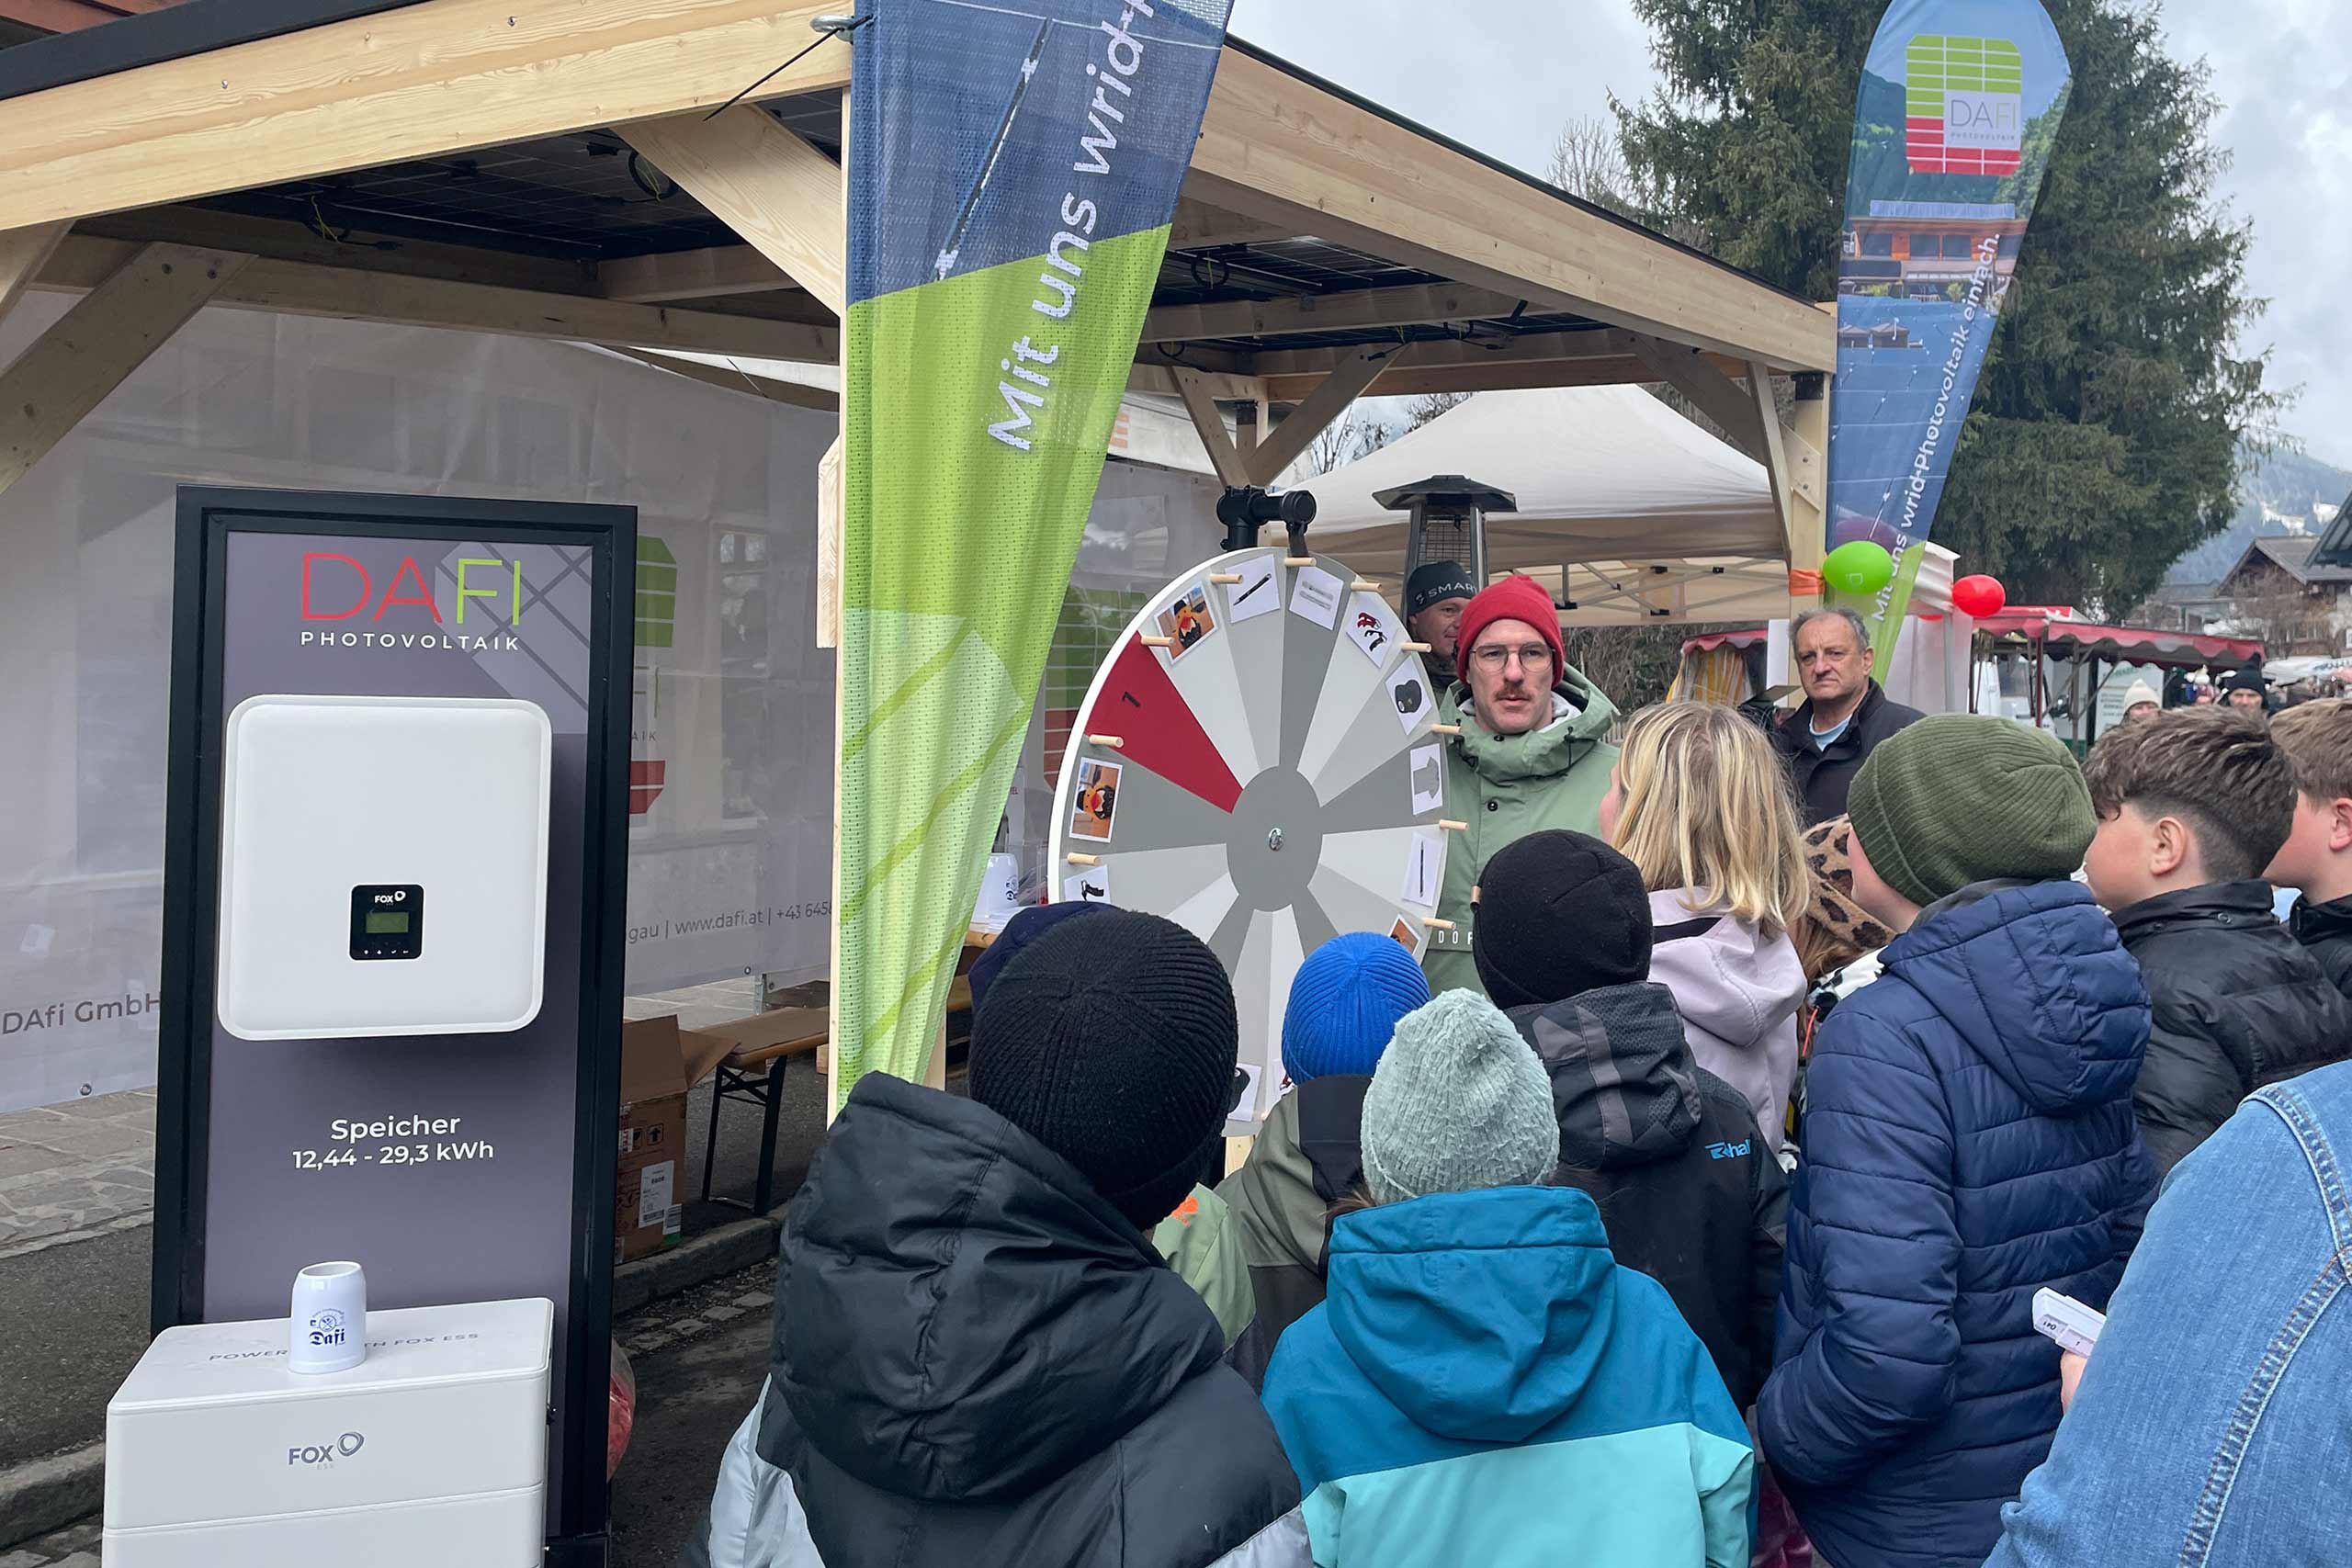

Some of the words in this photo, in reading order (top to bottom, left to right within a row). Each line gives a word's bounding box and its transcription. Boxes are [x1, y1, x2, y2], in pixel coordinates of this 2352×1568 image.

[1951, 99, 2017, 130] DAFI
[1963, 233, 2000, 321] einfach.
[988, 335, 1059, 451] Mit
[1032, 191, 1097, 318] uns
[300, 551, 521, 626] DAFI
[300, 631, 519, 650] PHOTOVOLTAIK
[374, 895, 393, 904] FOX
[675, 910, 763, 935] www.dafi.at
[776, 905, 801, 919] +43
[3, 1003, 64, 1034] DAfi
[74, 991, 162, 1022] GmbH
[331, 1114, 461, 1144] Speicher
[292, 1148, 356, 1171] 12,44
[379, 1145, 429, 1166] 29,3
[436, 1141, 493, 1160] kWh
[309, 1328, 345, 1347] Dafi
[394, 1337, 435, 1346] FOX
[443, 1333, 479, 1342] ESS
[288, 1445, 334, 1465] FOX
